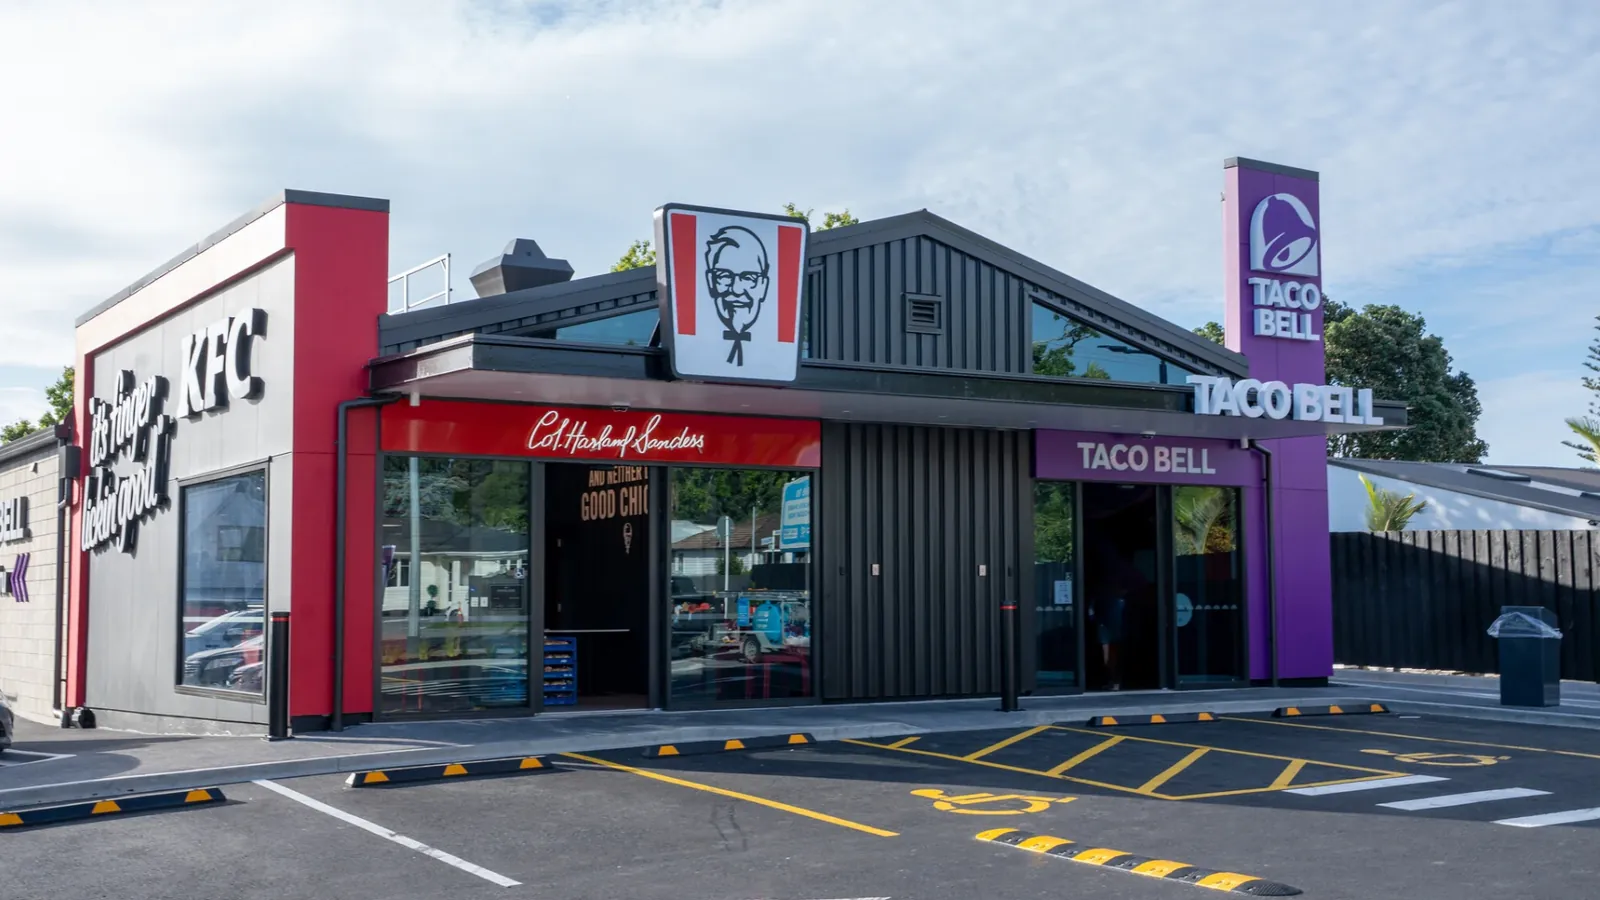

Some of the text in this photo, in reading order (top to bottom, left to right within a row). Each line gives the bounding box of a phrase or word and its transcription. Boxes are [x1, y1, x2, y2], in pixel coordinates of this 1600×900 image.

[1248, 277, 1321, 311] TACO
[1253, 309, 1321, 341] BELL
[177, 308, 265, 418] KFC
[110, 369, 158, 462] finger
[1186, 375, 1384, 426] TACO BELL
[527, 410, 705, 458] Col. Harland Sanders
[606, 465, 643, 484] NEITHER
[1077, 442, 1217, 475] TACO BELL
[581, 489, 616, 521] GOOD
